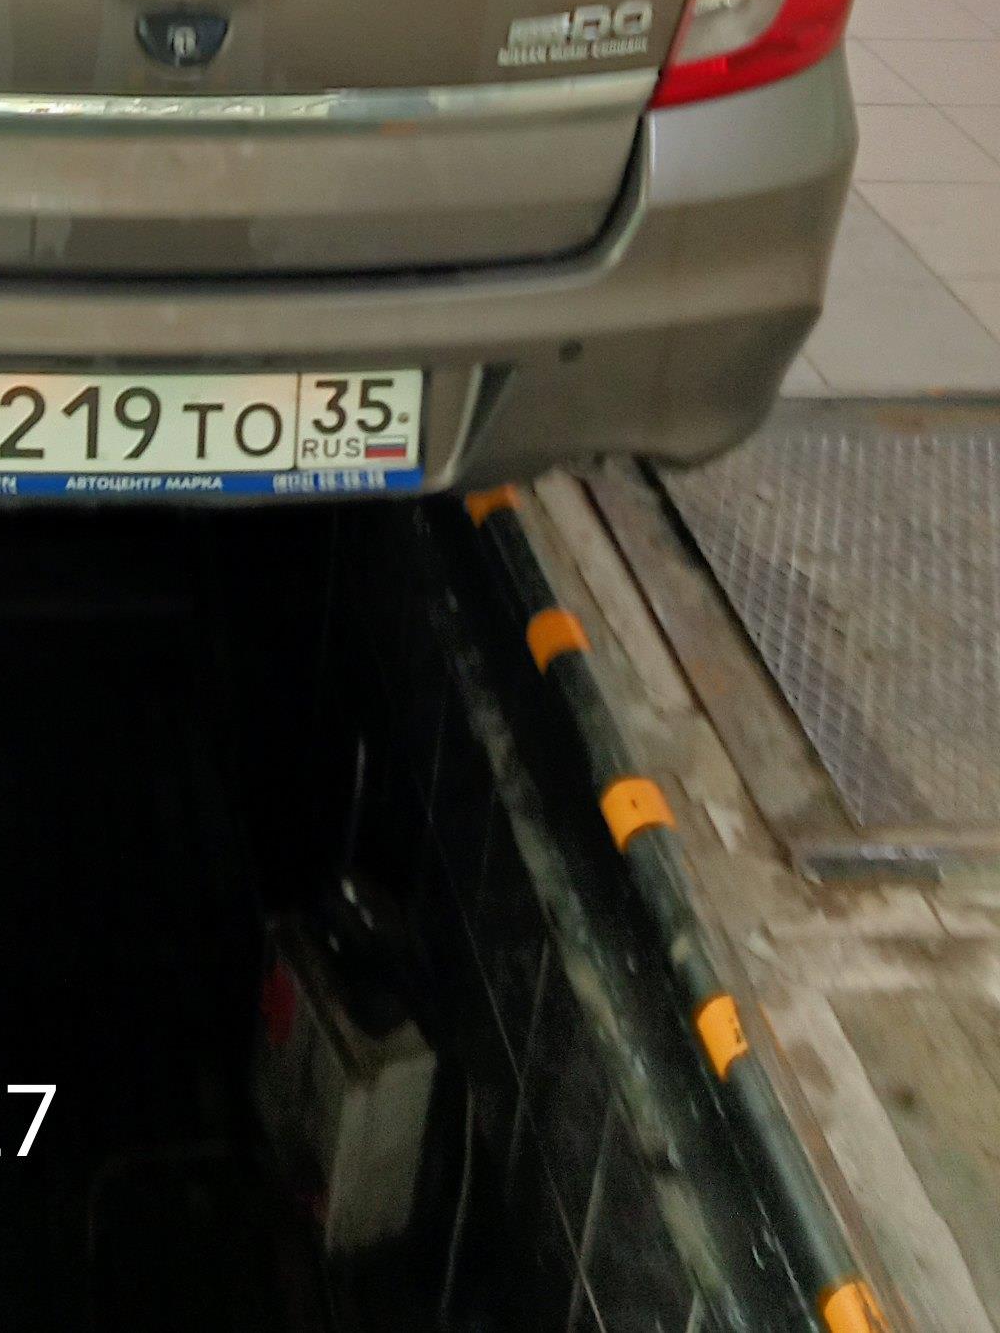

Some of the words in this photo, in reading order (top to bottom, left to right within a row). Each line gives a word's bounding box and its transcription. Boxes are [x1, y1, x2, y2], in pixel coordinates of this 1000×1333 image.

[312, 378, 395, 435] 35
[301, 437, 360, 459] RUS
[165, 475, 223, 492] МАРКА
